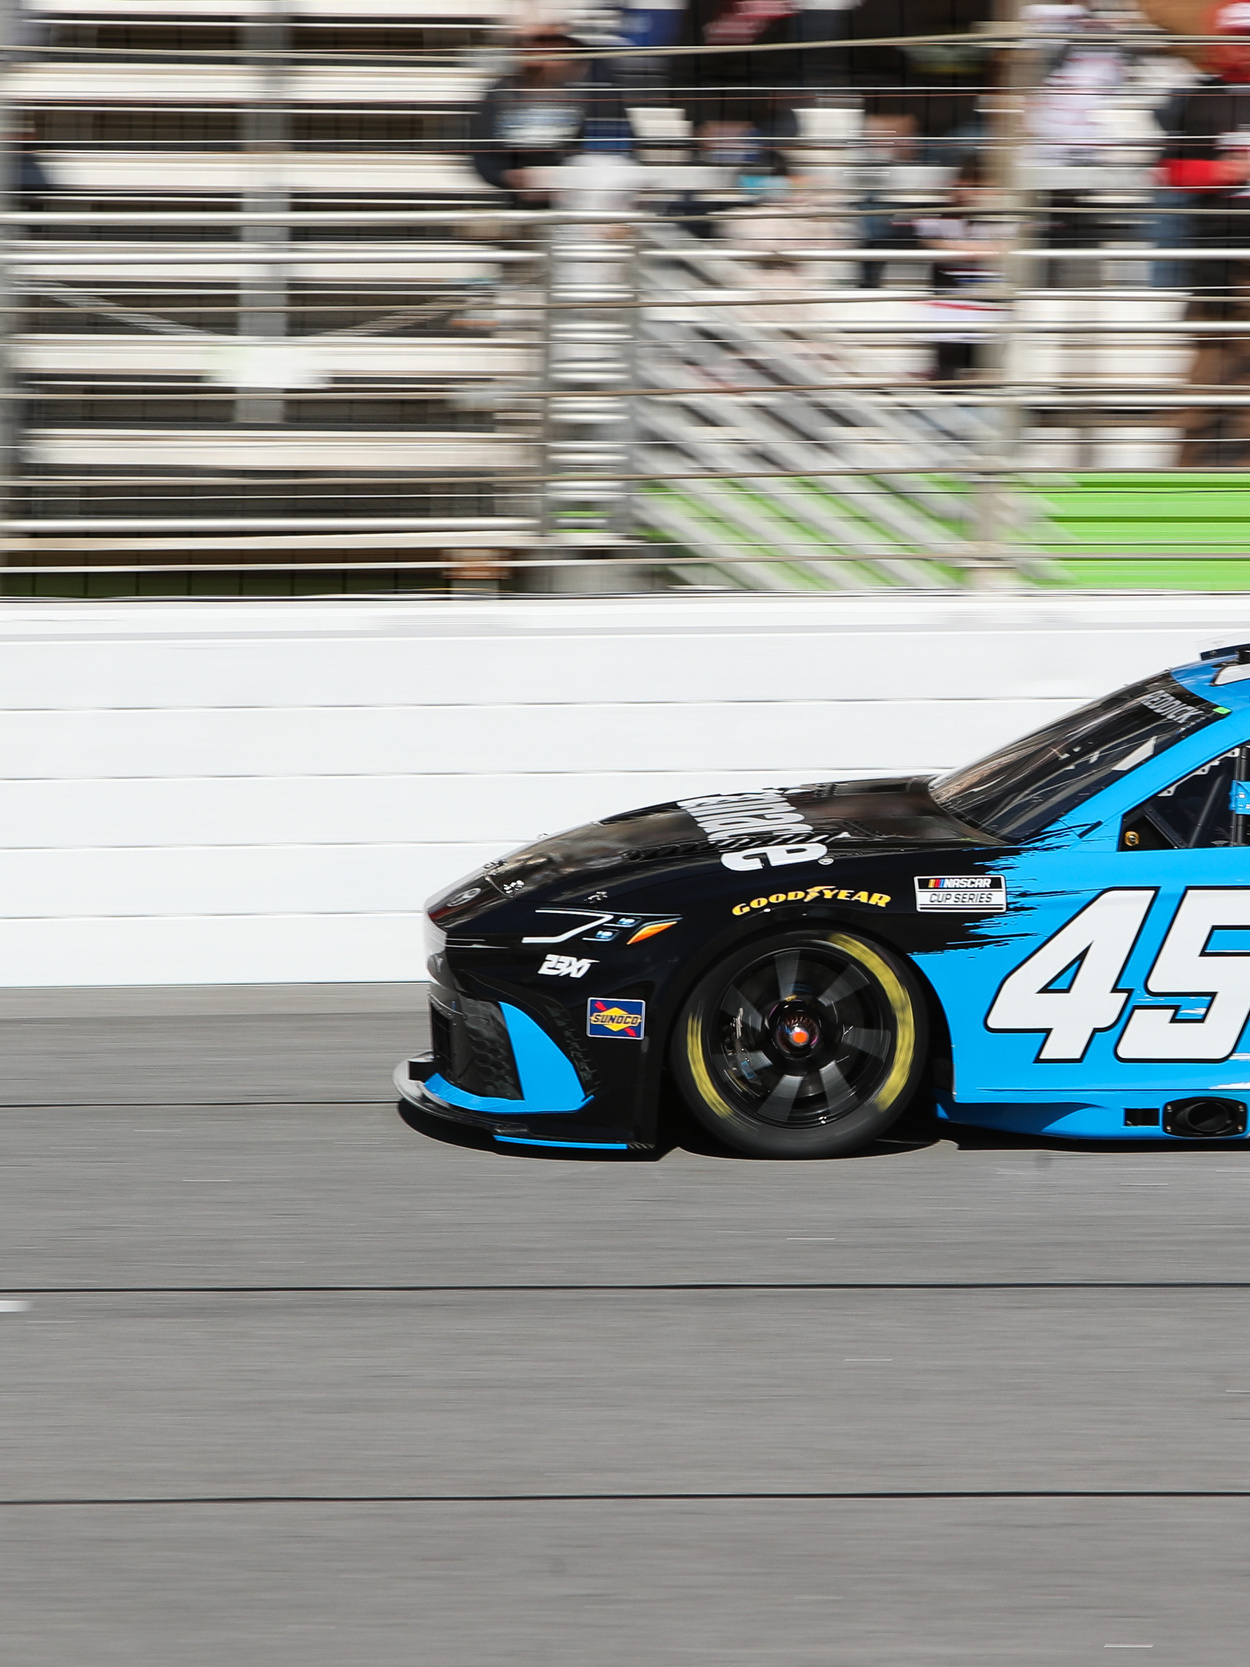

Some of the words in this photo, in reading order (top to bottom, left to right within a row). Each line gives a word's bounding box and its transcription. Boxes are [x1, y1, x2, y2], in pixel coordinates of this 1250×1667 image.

[943, 878, 992, 888] NASCAR
[732, 886, 891, 916] GOODYEAR
[929, 893, 952, 903] CUP
[953, 892, 993, 903] SERIES
[593, 1014, 640, 1025] SUNOCO
